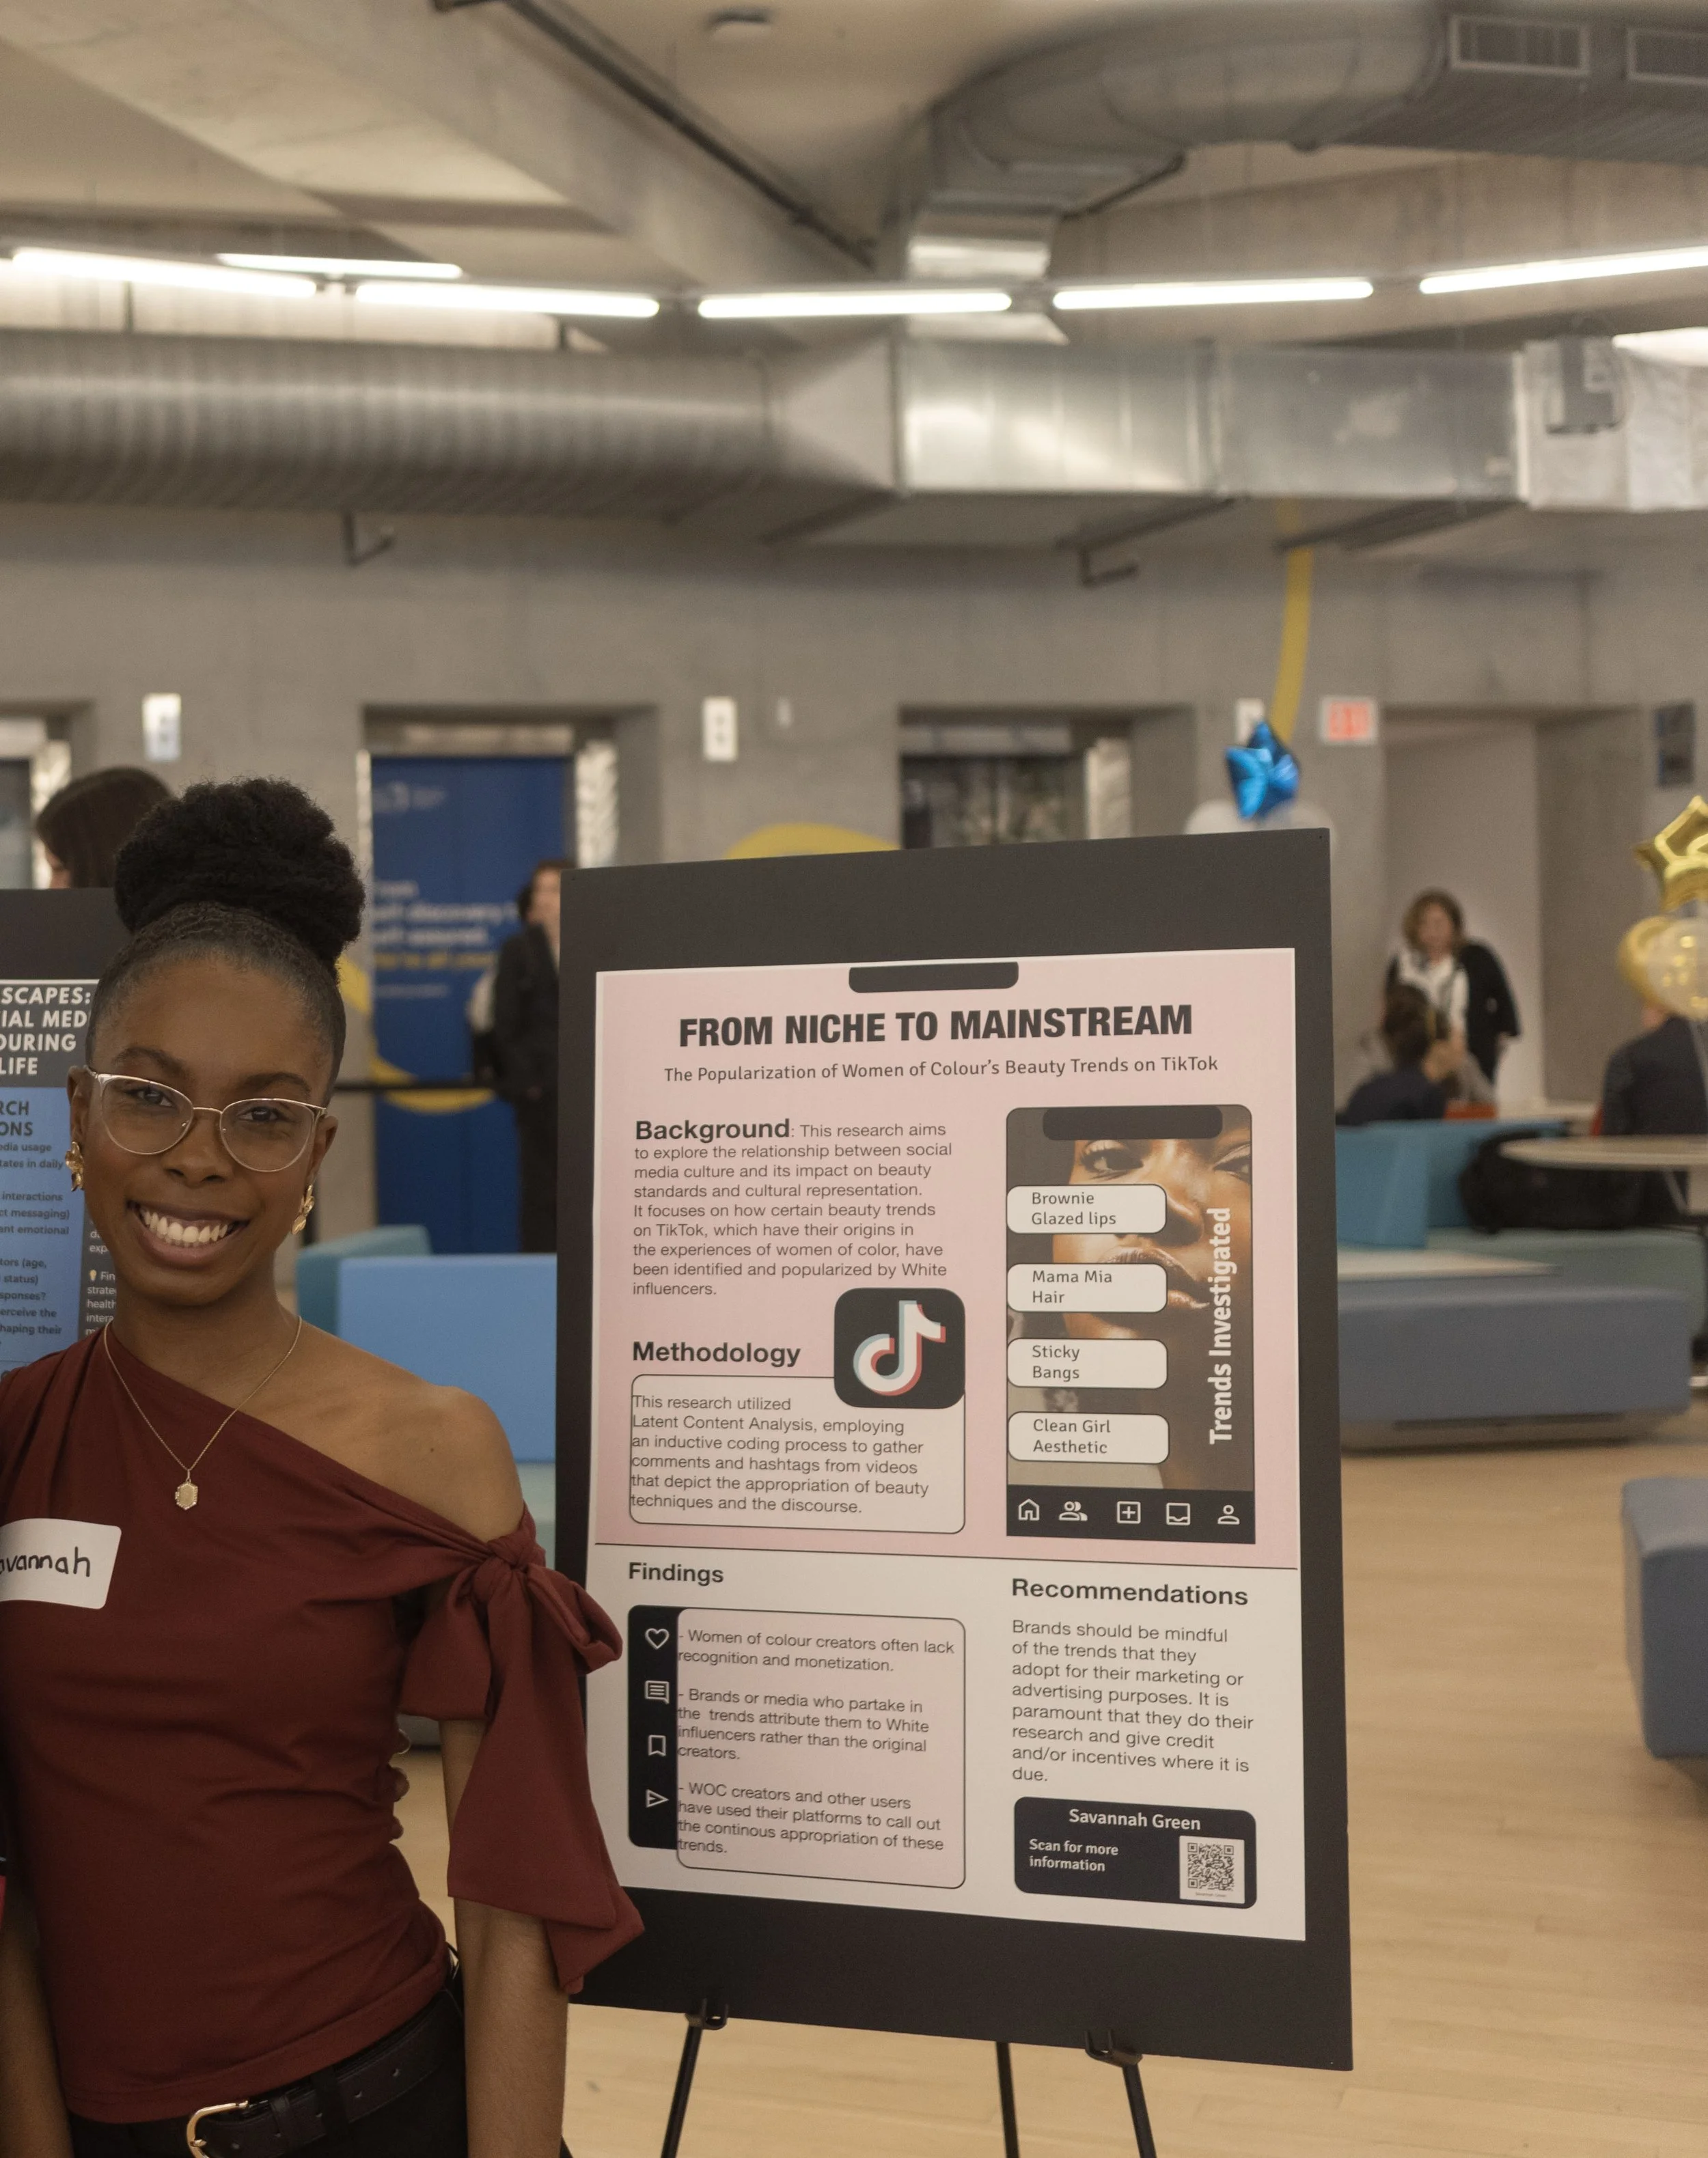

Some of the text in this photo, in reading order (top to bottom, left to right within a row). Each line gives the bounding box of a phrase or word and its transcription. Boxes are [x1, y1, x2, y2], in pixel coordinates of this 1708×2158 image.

[0, 1010, 33, 1027] IAL
[680, 1004, 1192, 1047] FROM NICHE TO MAINSTREAM
[664, 1055, 1218, 1084] The Popularization of Women of Colour’s Beauty Trends on TikTok
[636, 1118, 946, 1144] Background: This research aims
[22, 1144, 52, 1154] usage
[634, 1142, 952, 1161] to explore the relationship between social
[27, 1159, 36, 1168] in
[40, 1159, 64, 1170] daily
[2, 1191, 64, 1202] interactions
[634, 1183, 922, 1200] standards and cultural representation.
[1032, 1192, 1094, 1204] Brownie
[11, 1208, 70, 1220] messaging)
[1032, 1211, 1116, 1228] Glazed lips
[17, 1226, 69, 1234] emotional
[633, 1223, 913, 1239] on TikTok, which have their origins in
[22, 1258, 46, 1269] (age,
[633, 1262, 947, 1279] been identified and popularized by White
[4, 1275, 38, 1286] status)
[1032, 1270, 1112, 1283] Mama Mia
[87, 1286, 117, 1295] strate
[633, 1282, 716, 1295] influencers.
[1033, 1290, 1064, 1303] Hair
[40, 1308, 57, 1318] the
[38, 1325, 62, 1334] their
[1207, 1207, 1238, 1445] Trends Investigated
[633, 1342, 801, 1368] Methodology
[1032, 1344, 1079, 1361] Sticky
[1033, 1366, 1079, 1382] Bangs
[633, 1394, 791, 1411] This research utilized
[633, 1415, 904, 1436] Latent Content Analysis, employing
[1033, 1418, 1111, 1433] Clean Girl
[1033, 1439, 1107, 1454] Aesthetic
[631, 1494, 862, 1513] techniques and the discourse.
[629, 1562, 724, 1586] Findings
[1013, 1578, 1248, 1605] Recommendations
[1013, 1620, 1227, 1642] Brands should be mindful
[688, 1629, 954, 1654] Women of colour creators often lack
[1012, 1662, 1243, 1688] adopt for their marketing or
[689, 1688, 922, 1713] Brands or media who partake in
[1013, 1683, 1229, 1706] advertising purposes. It is
[1013, 1706, 1254, 1729] paramount that they do their
[678, 1725, 926, 1754] influencers rather than the original
[678, 1747, 740, 1760] creators.
[1013, 1747, 1249, 1772] and/or incentives where it is
[1012, 1767, 1047, 1782] due.
[689, 1782, 911, 1809] WOC creators and other users
[1069, 1808, 1200, 1830] Savannah Green
[680, 1838, 727, 1853] trends.
[1030, 1838, 1118, 1855] Scan for more
[1030, 1855, 1105, 1872] information
